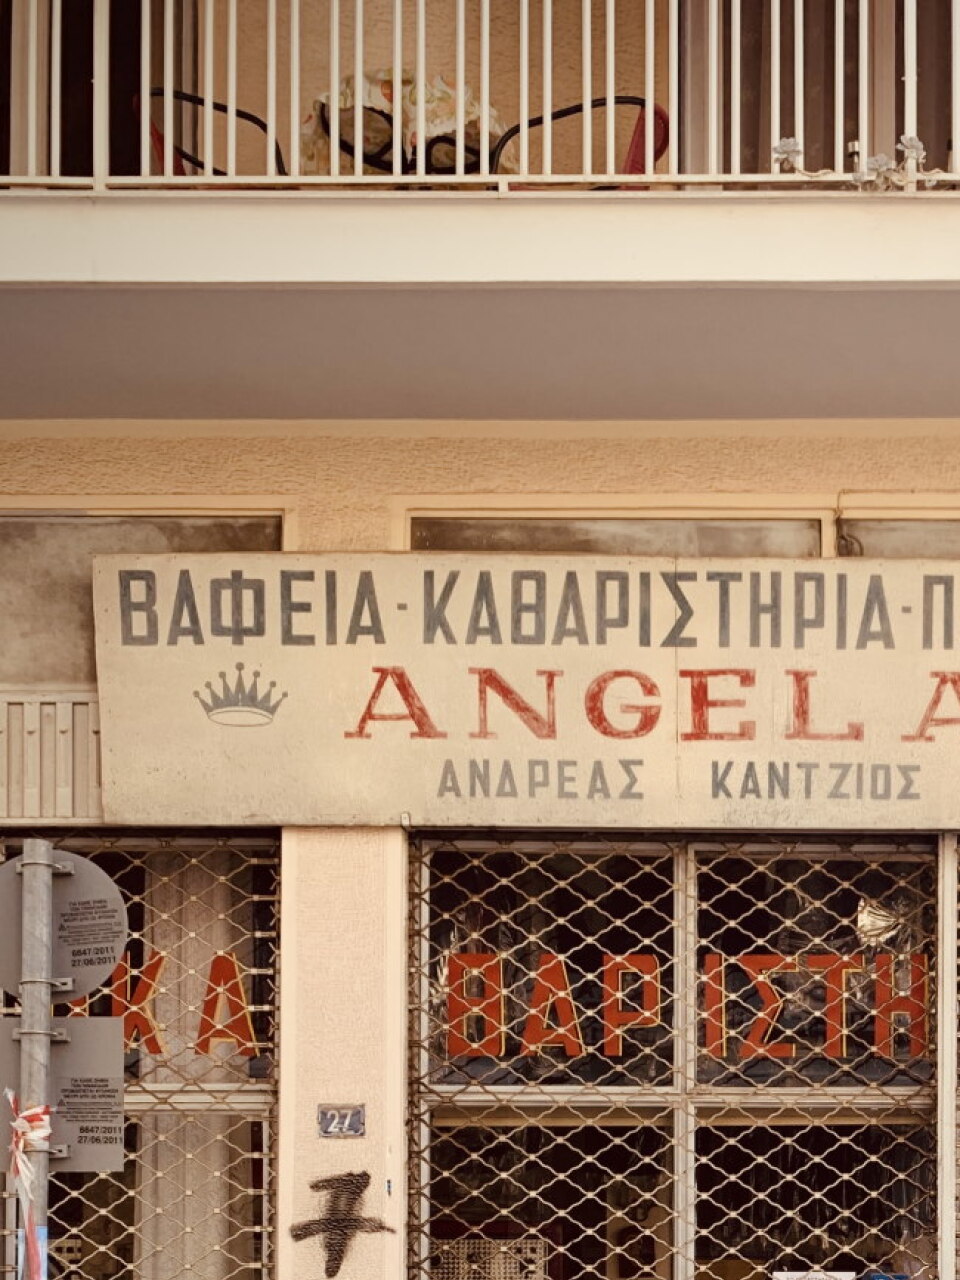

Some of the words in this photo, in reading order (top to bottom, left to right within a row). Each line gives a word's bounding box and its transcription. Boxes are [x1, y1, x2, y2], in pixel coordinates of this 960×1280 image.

[437, 758, 645, 800] ΑΝΔΡΕΑΣ
[711, 760, 921, 801] ΚΑΝΤΖΙΟΣ
[326, 1110, 352, 1133] 27
